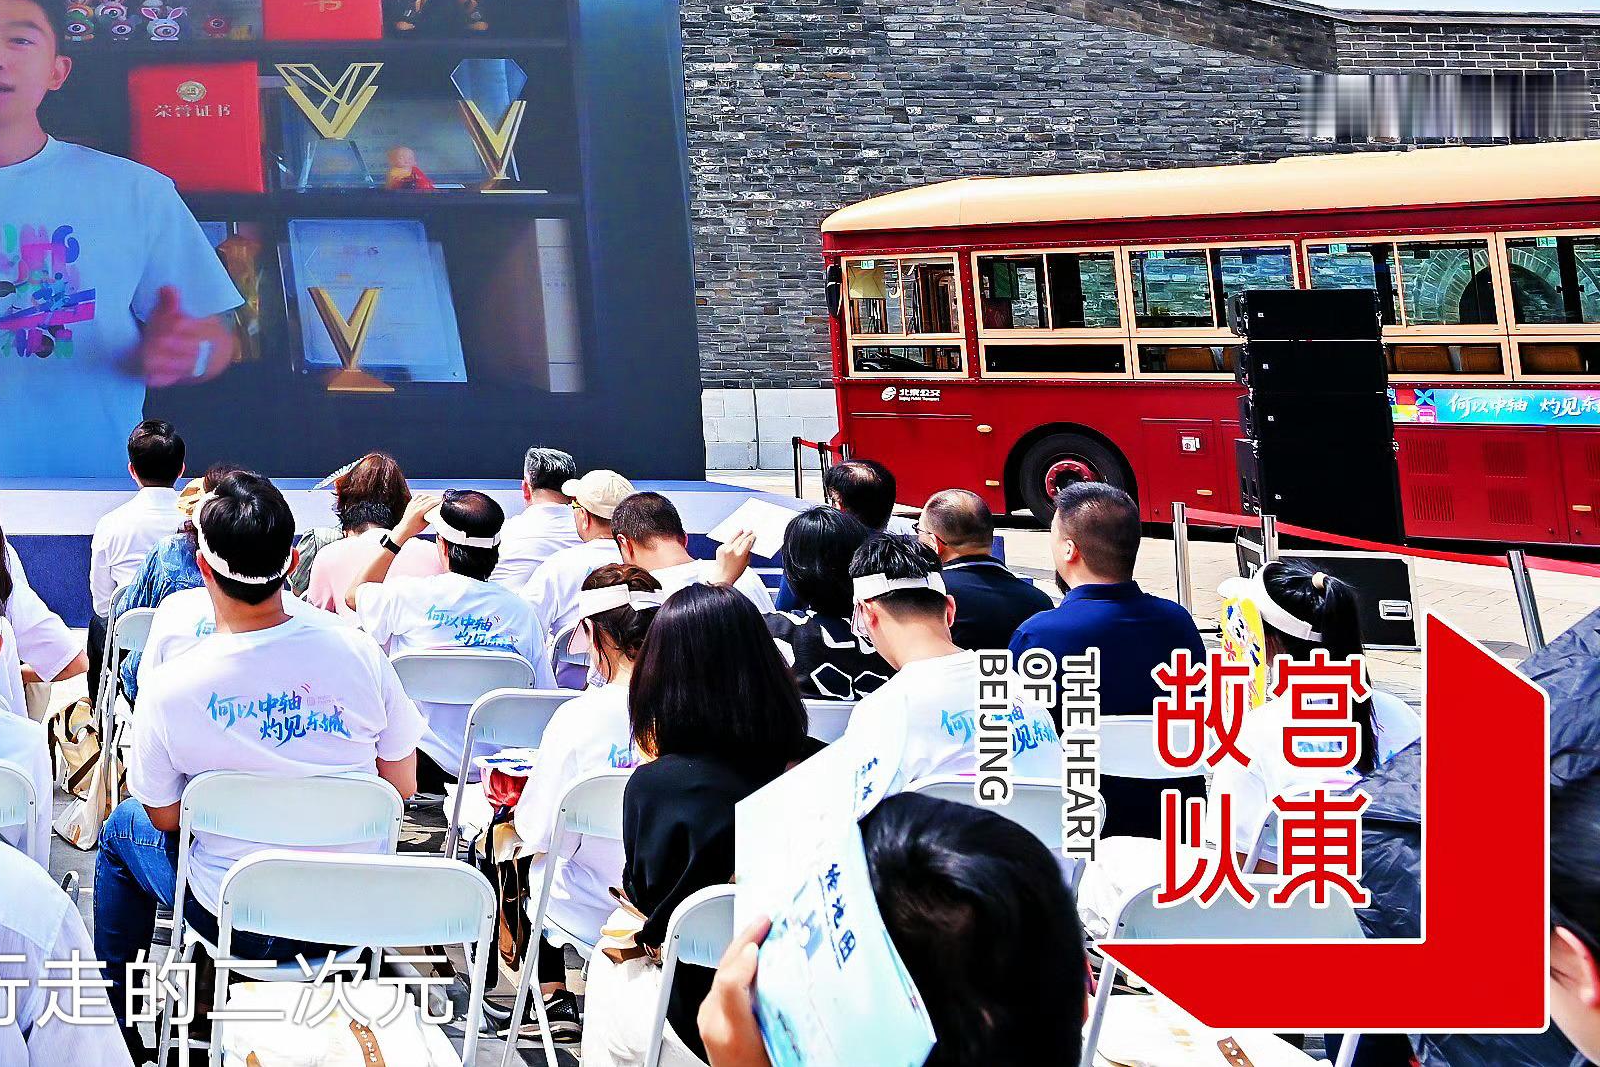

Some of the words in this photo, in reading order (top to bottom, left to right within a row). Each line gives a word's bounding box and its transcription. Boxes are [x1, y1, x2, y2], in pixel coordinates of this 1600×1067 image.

[155, 103, 231, 118] 荣誉证书
[899, 388, 941, 397] 北京公交
[1448, 393, 1529, 421] 何以中轴
[426, 604, 493, 630] 何以中轴
[206, 690, 302, 732] 何以中轴
[260, 705, 351, 748] 灼见东城
